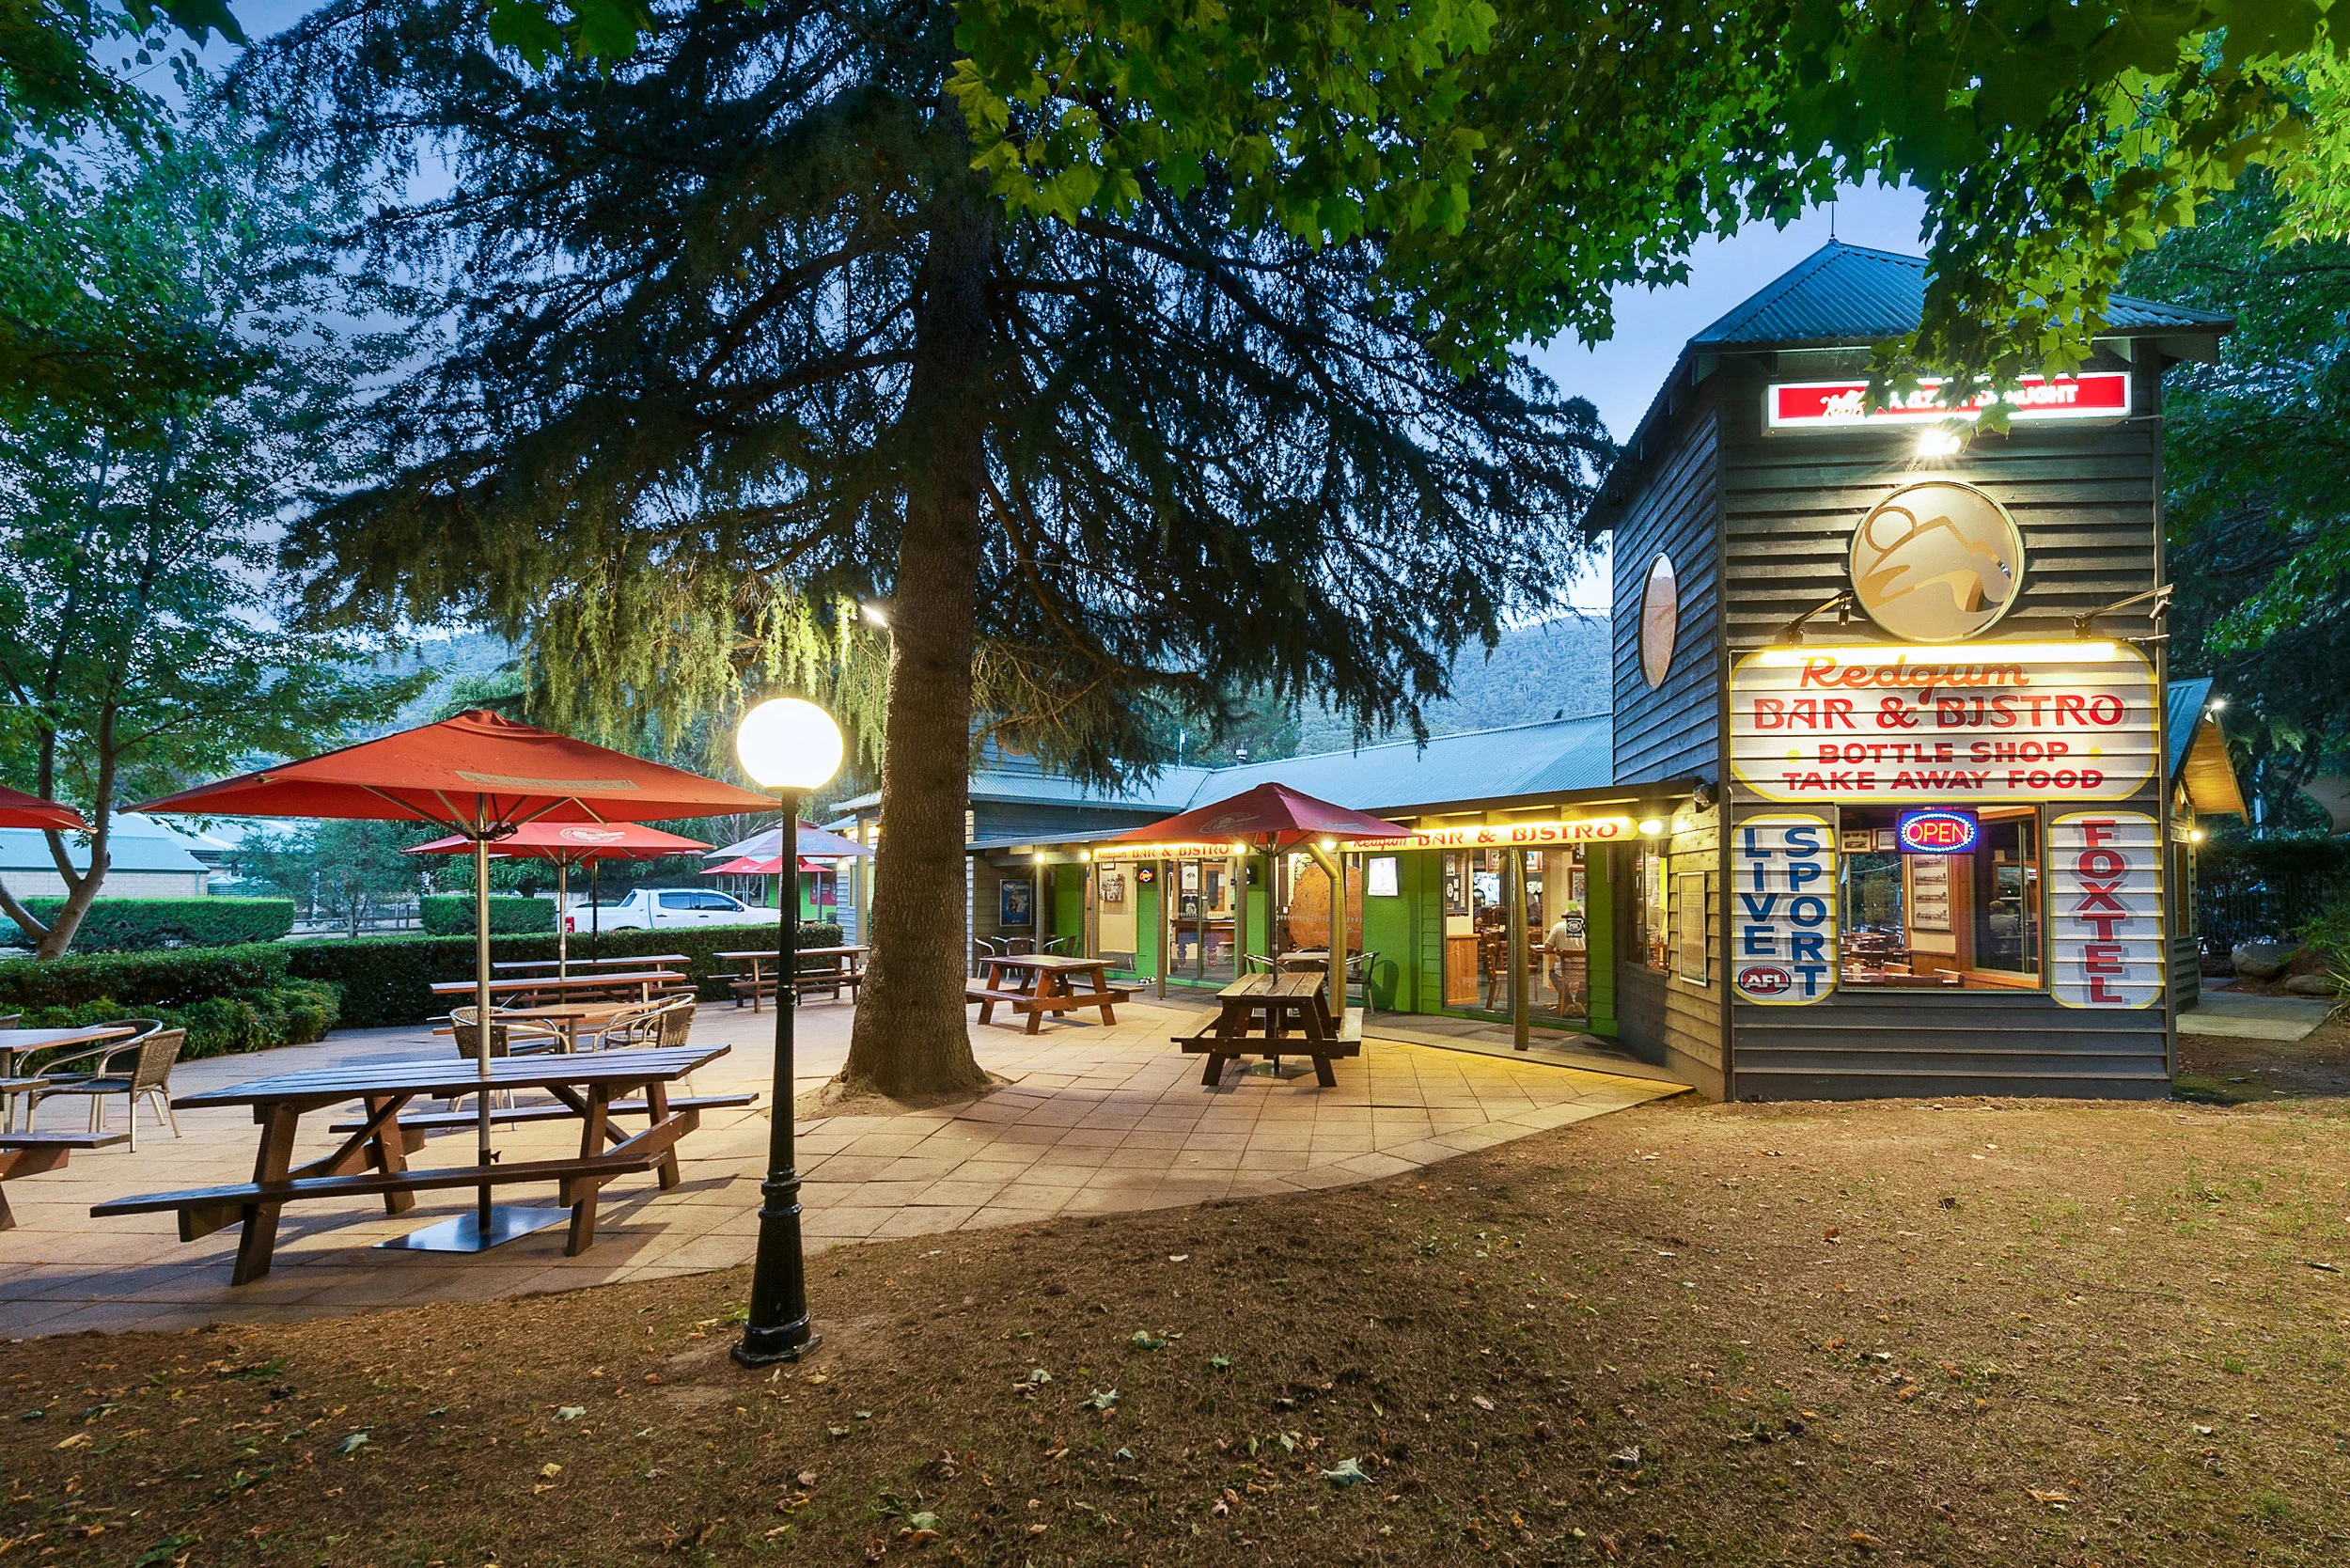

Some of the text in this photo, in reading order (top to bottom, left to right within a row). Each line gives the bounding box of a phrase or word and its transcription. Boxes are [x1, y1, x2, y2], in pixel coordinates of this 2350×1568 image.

[1799, 654, 2030, 705] Redgum
[1754, 695, 2124, 729] BAR & BISTRO
[1818, 741, 2069, 764] BOTTLE SHOP
[1782, 769, 2104, 791] TAKE AWAY FOOD
[1418, 832, 1464, 846] BAR
[1478, 829, 1496, 843] &
[1512, 823, 1618, 841] BISTRO
[1905, 822, 1969, 844] OPEN
[1132, 848, 1156, 858] BAR
[1162, 847, 1173, 857] &
[1179, 844, 1230, 856] BISTRO
[1741, 827, 1779, 955] LIVE
[1784, 826, 1827, 996] SPORT
[2076, 820, 2126, 1003] FOXTEL
[1742, 974, 1790, 989] AFL
